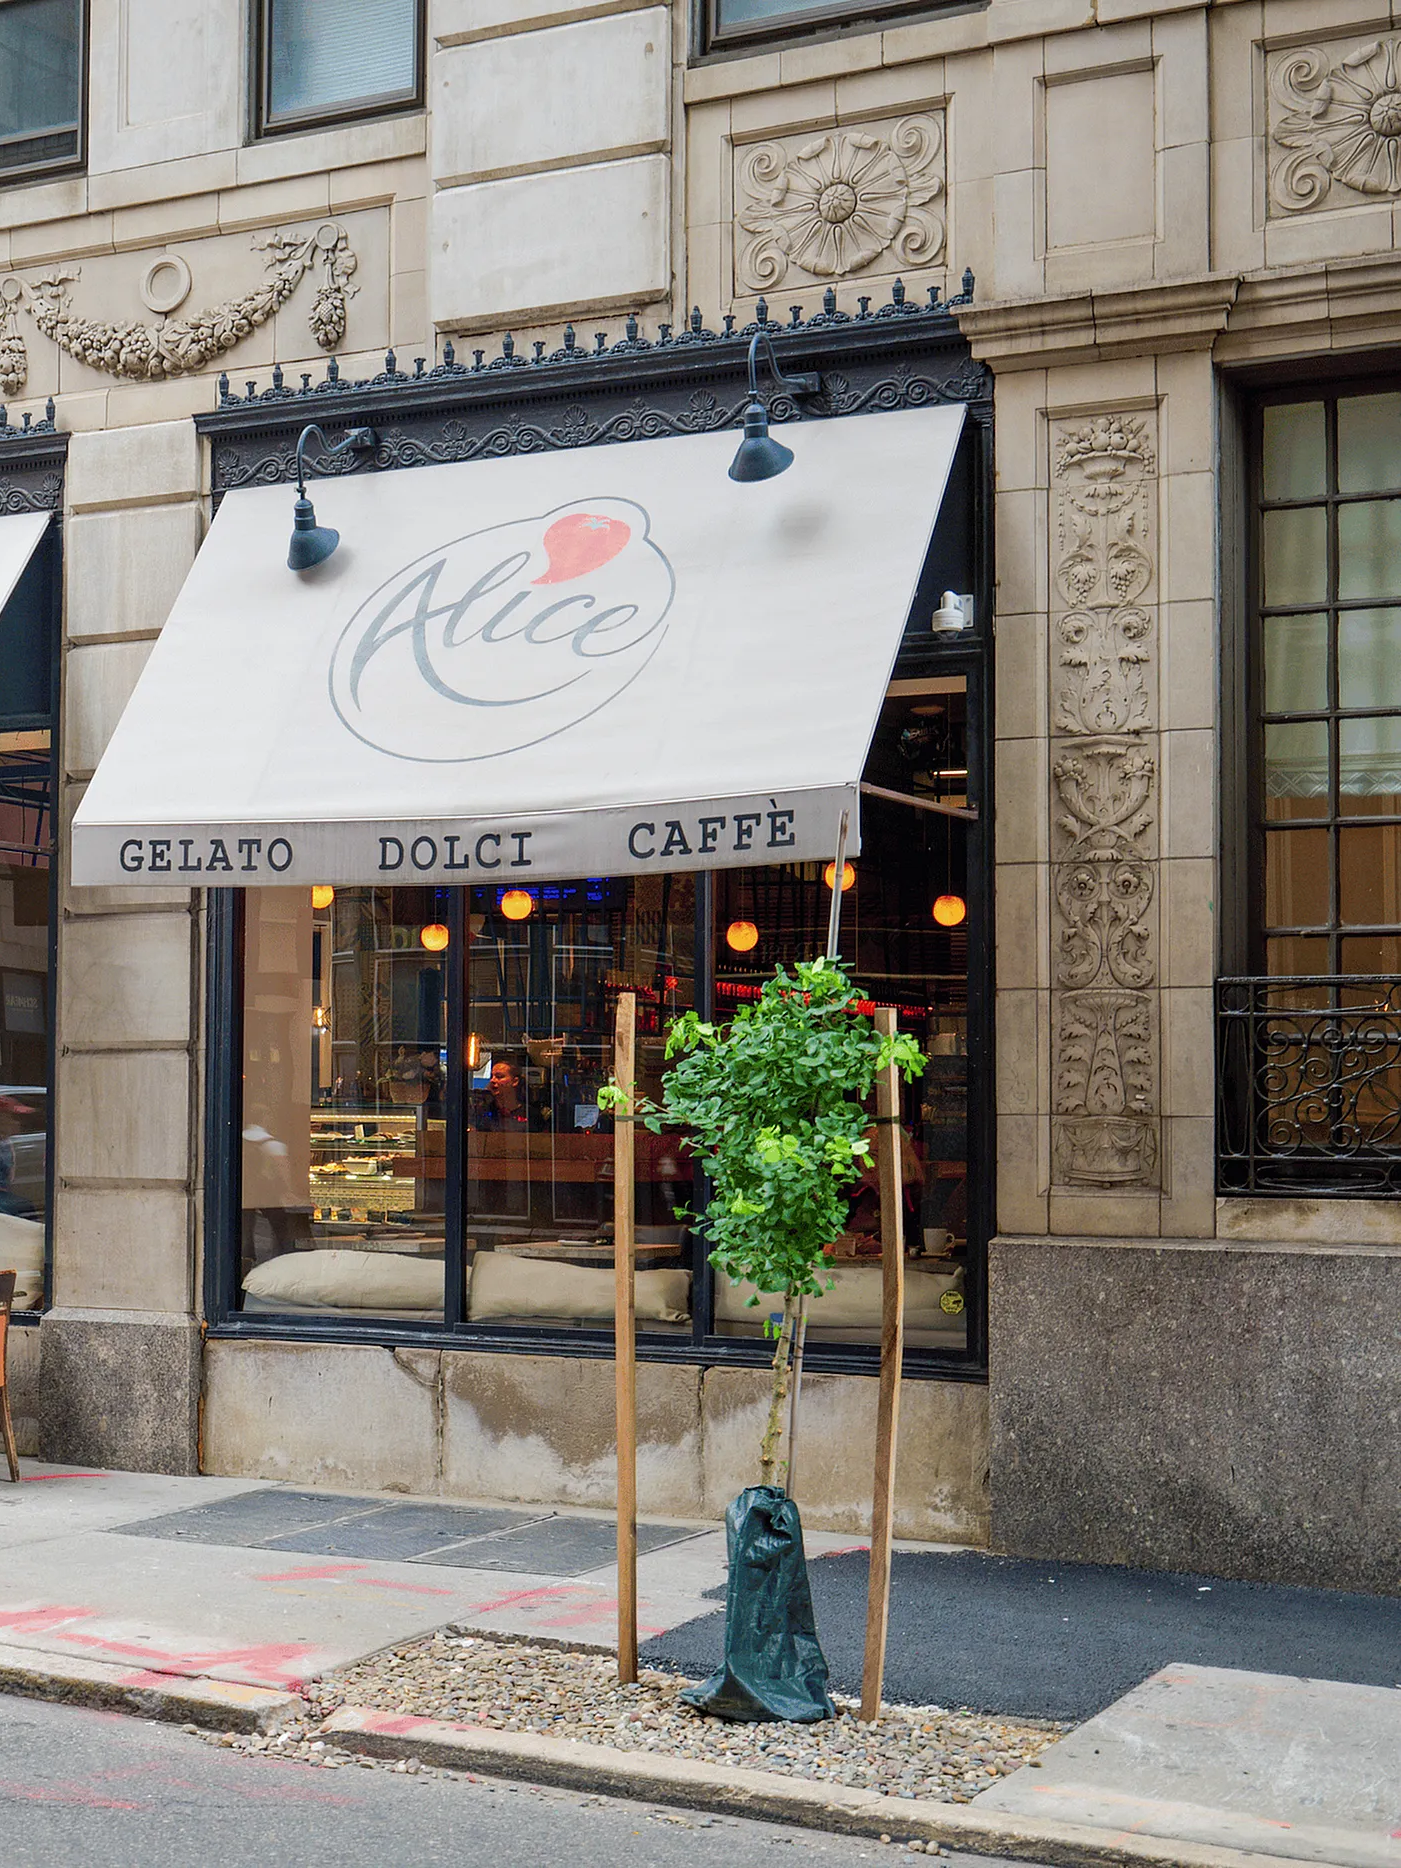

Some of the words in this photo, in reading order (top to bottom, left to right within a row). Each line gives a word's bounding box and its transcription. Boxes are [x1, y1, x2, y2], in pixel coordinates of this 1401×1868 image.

[350, 551, 639, 712] Alice
[119, 837, 294, 873] GELATO
[379, 831, 533, 872] DOLCI
[628, 799, 796, 860] CAFFÈ
